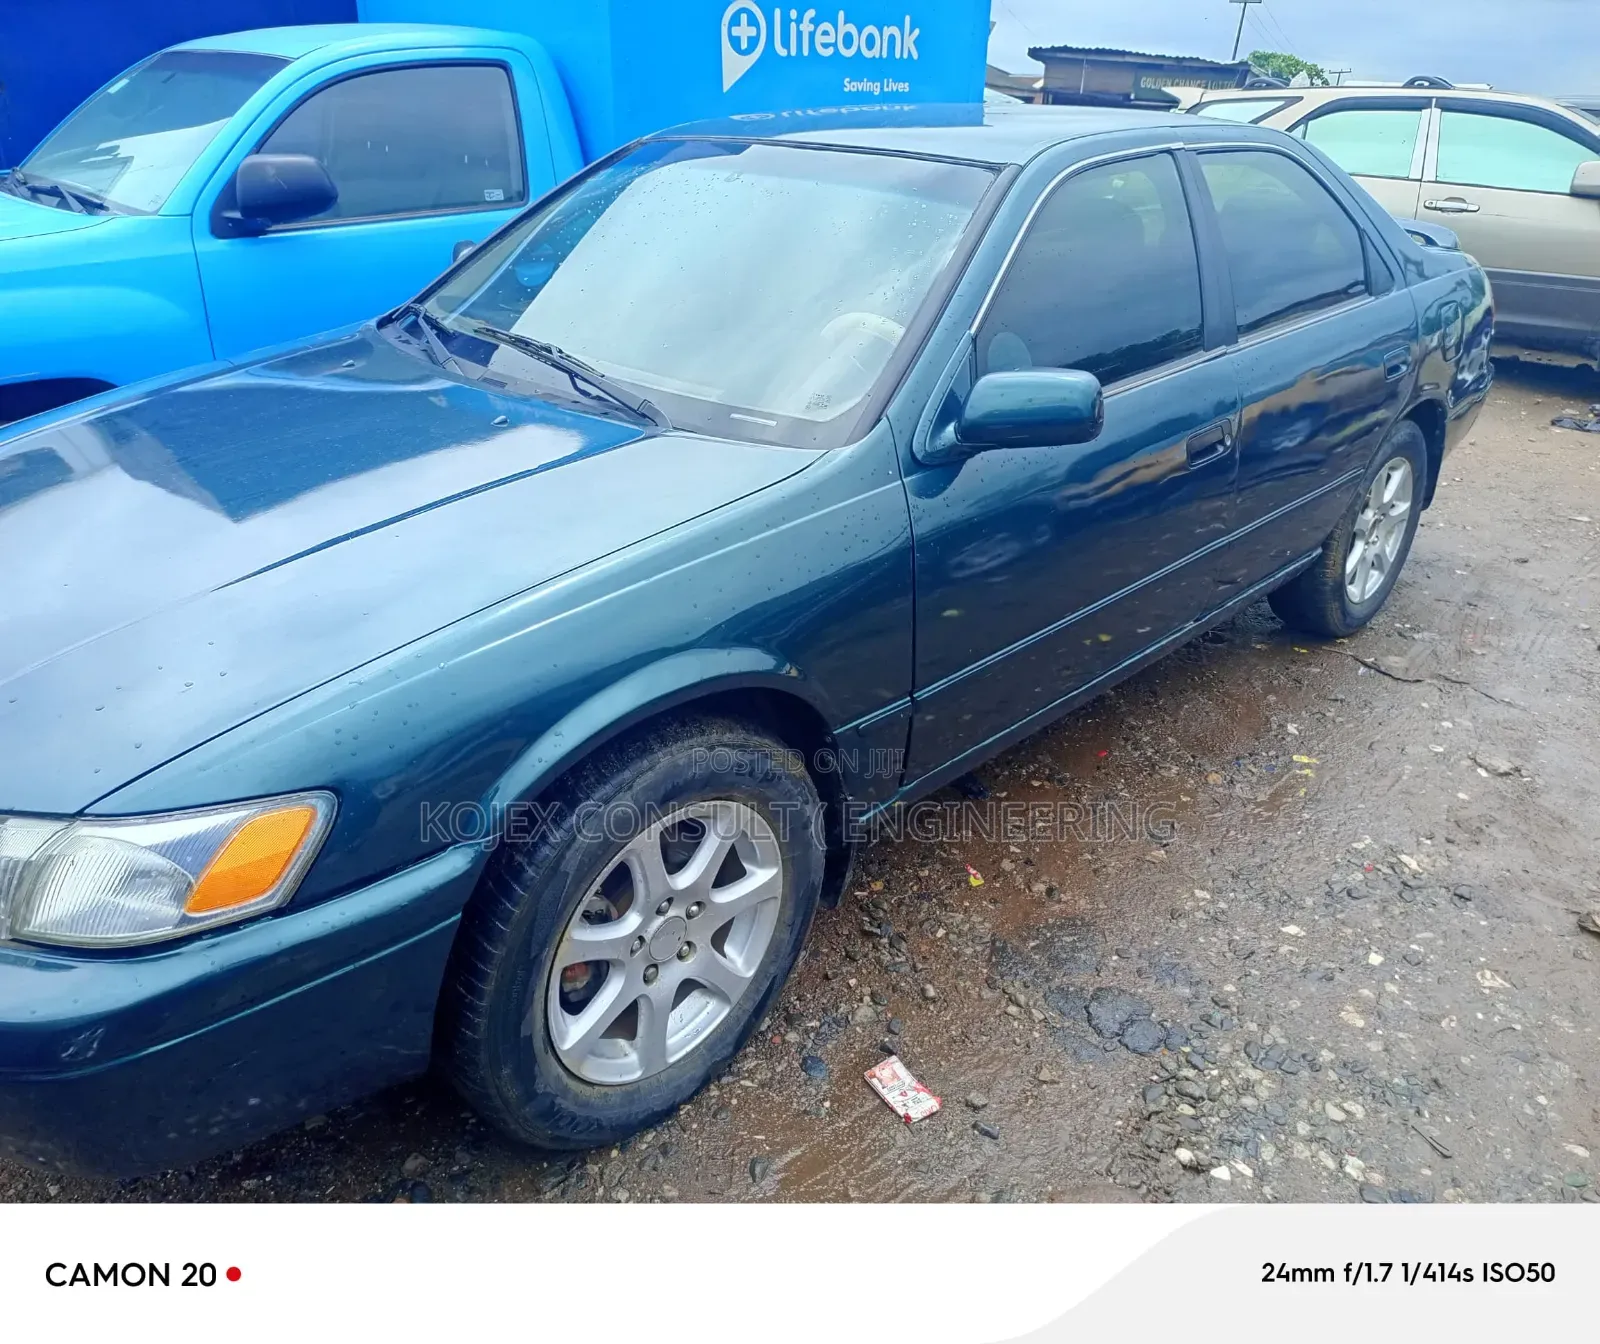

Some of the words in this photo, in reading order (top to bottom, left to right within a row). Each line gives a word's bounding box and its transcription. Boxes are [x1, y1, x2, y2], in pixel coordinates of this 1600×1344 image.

[843, 78, 881, 95] Saving
[883, 78, 910, 93] Lives
[1140, 76, 1172, 89] GOLDEN
